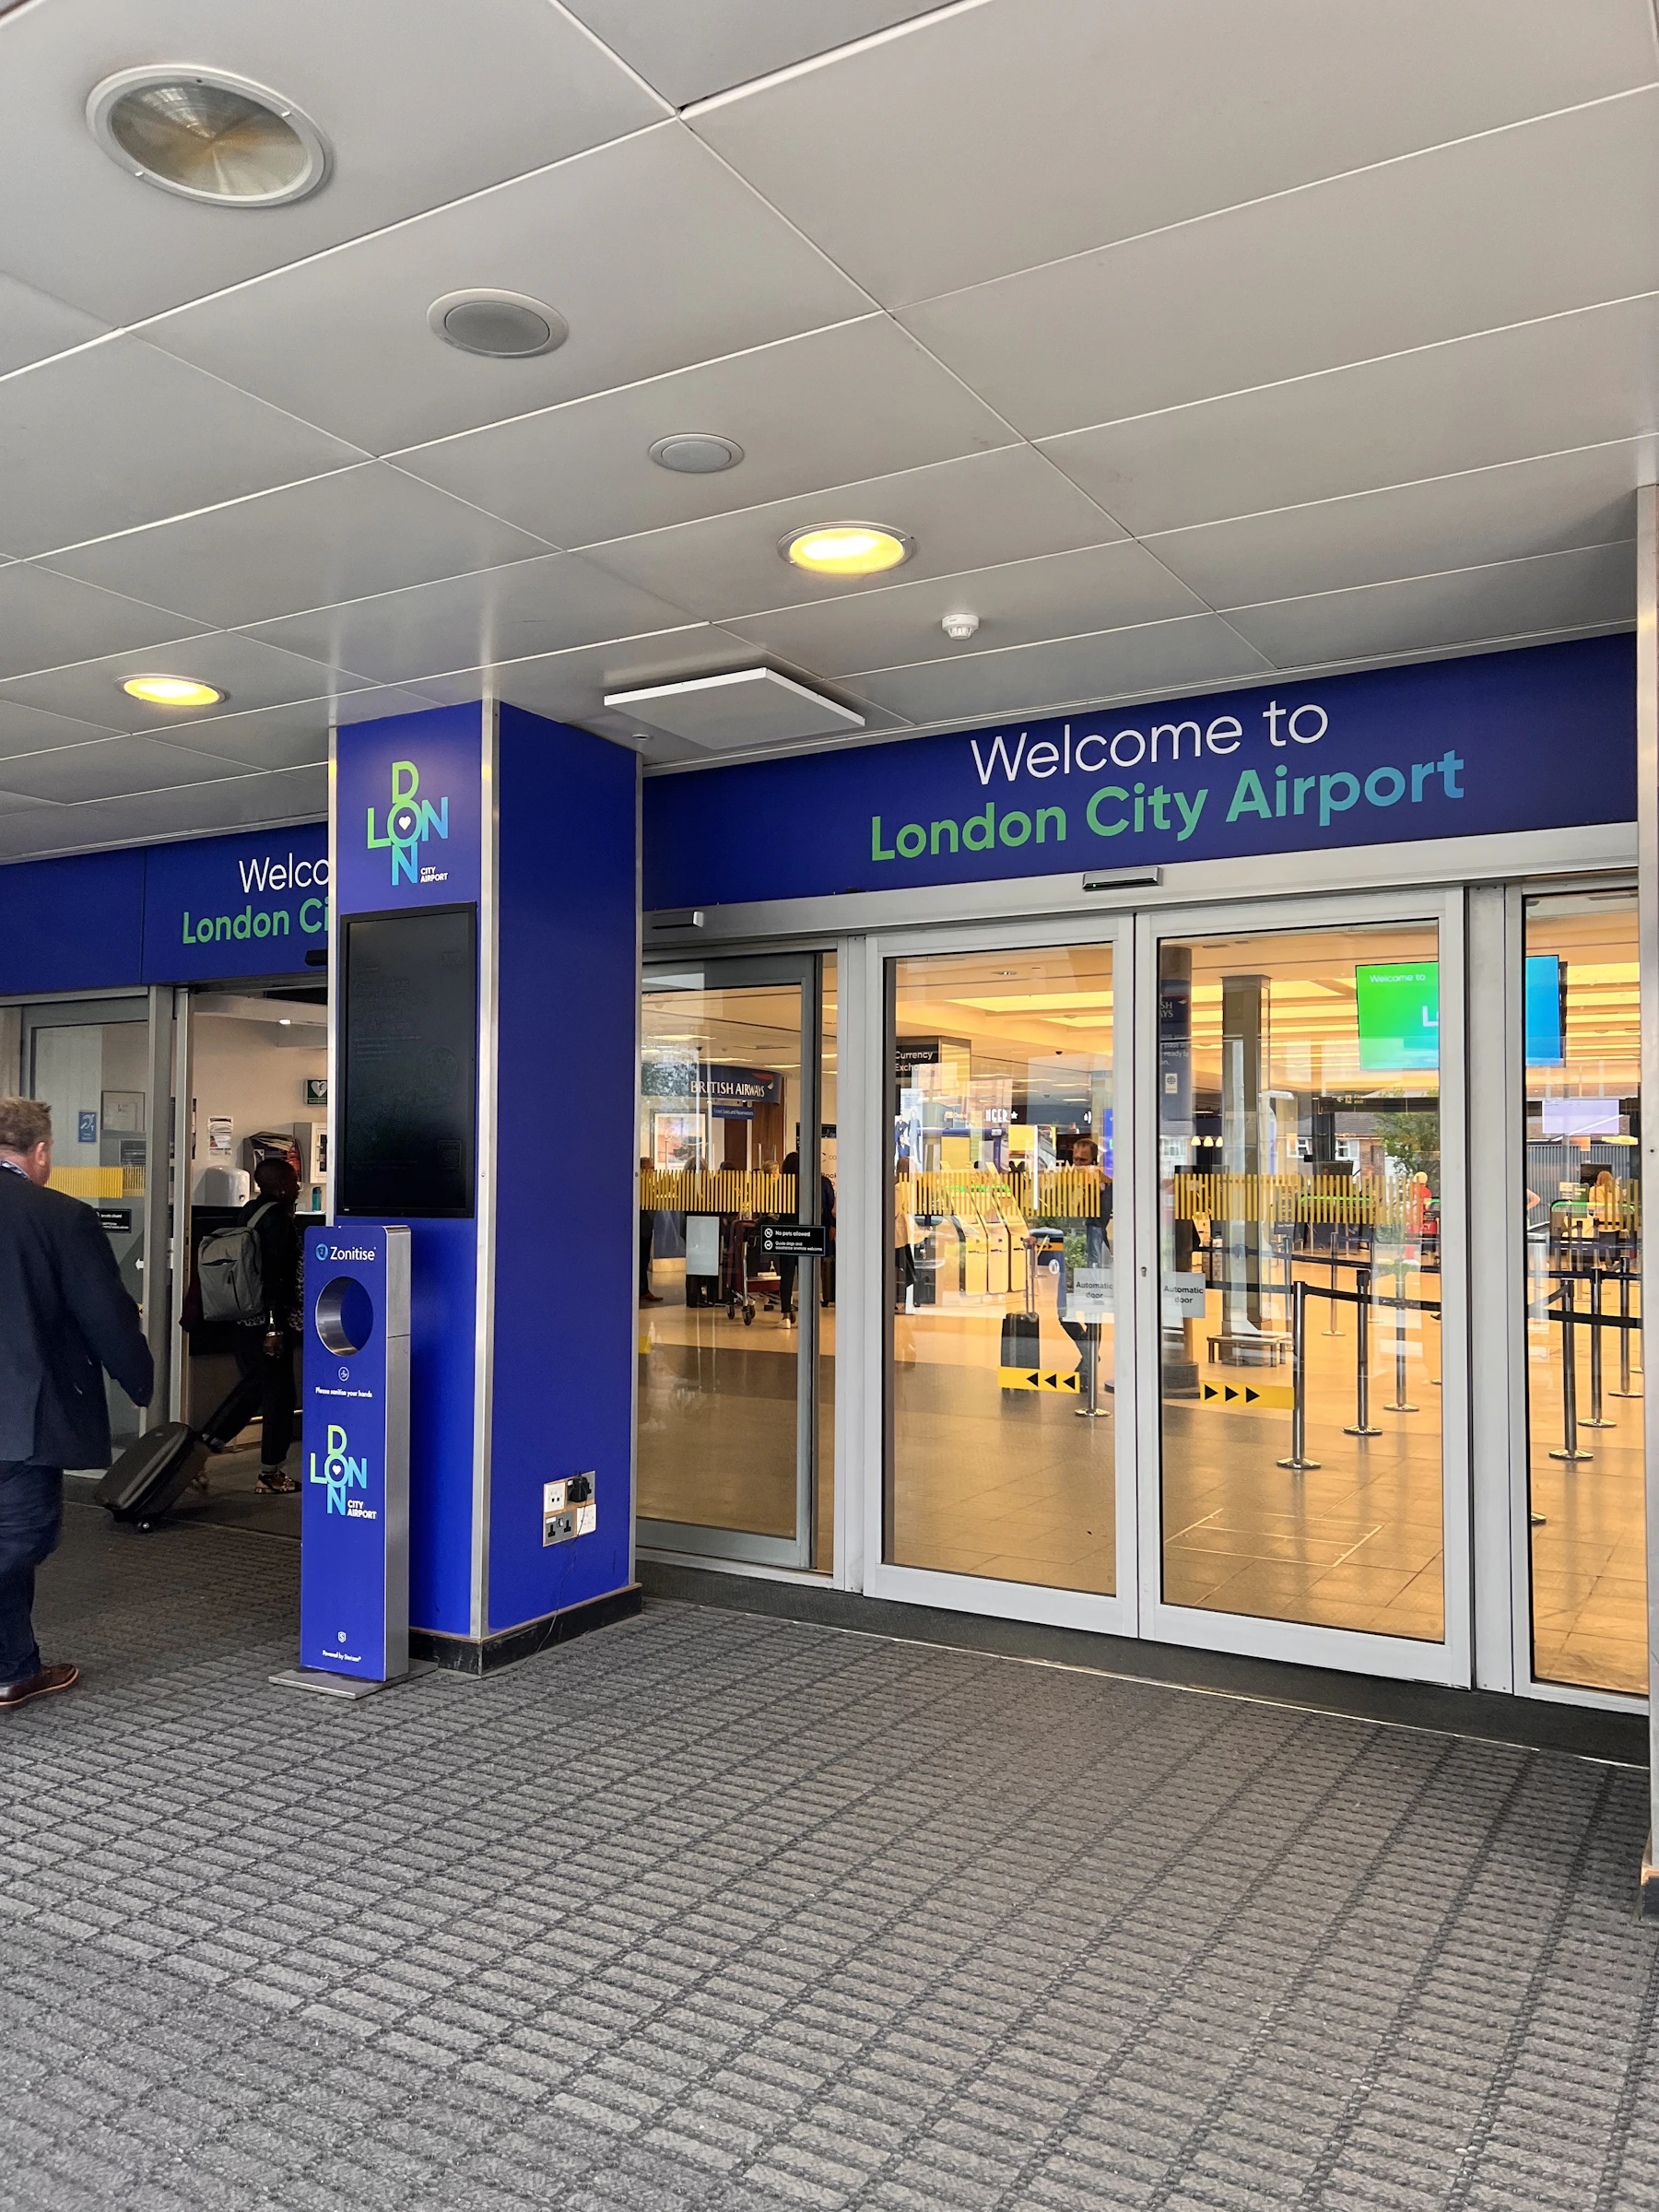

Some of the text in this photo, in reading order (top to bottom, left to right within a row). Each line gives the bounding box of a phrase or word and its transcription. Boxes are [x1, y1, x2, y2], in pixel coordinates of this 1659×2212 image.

[971, 700, 1329, 785] Welcome to
[871, 749, 1465, 861] London City Airport
[238, 852, 329, 893] Welco
[420, 866, 436, 875] CITY
[420, 873, 449, 883] AIRPORT
[182, 904, 290, 945] London
[1370, 973, 1413, 982] Welcome
[894, 1051, 934, 1060] Currency
[894, 1063, 936, 1072] Excha
[690, 1080, 765, 1098] BRITISH AIRWAYS
[1046, 1159, 1078, 1173] ATM
[1076, 1281, 1113, 1290] Automatic
[1163, 1285, 1204, 1294] Automatic
[1174, 1296, 1194, 1304] door
[347, 1500, 364, 1509] CITY
[347, 1508, 377, 1520] AIRPORT
